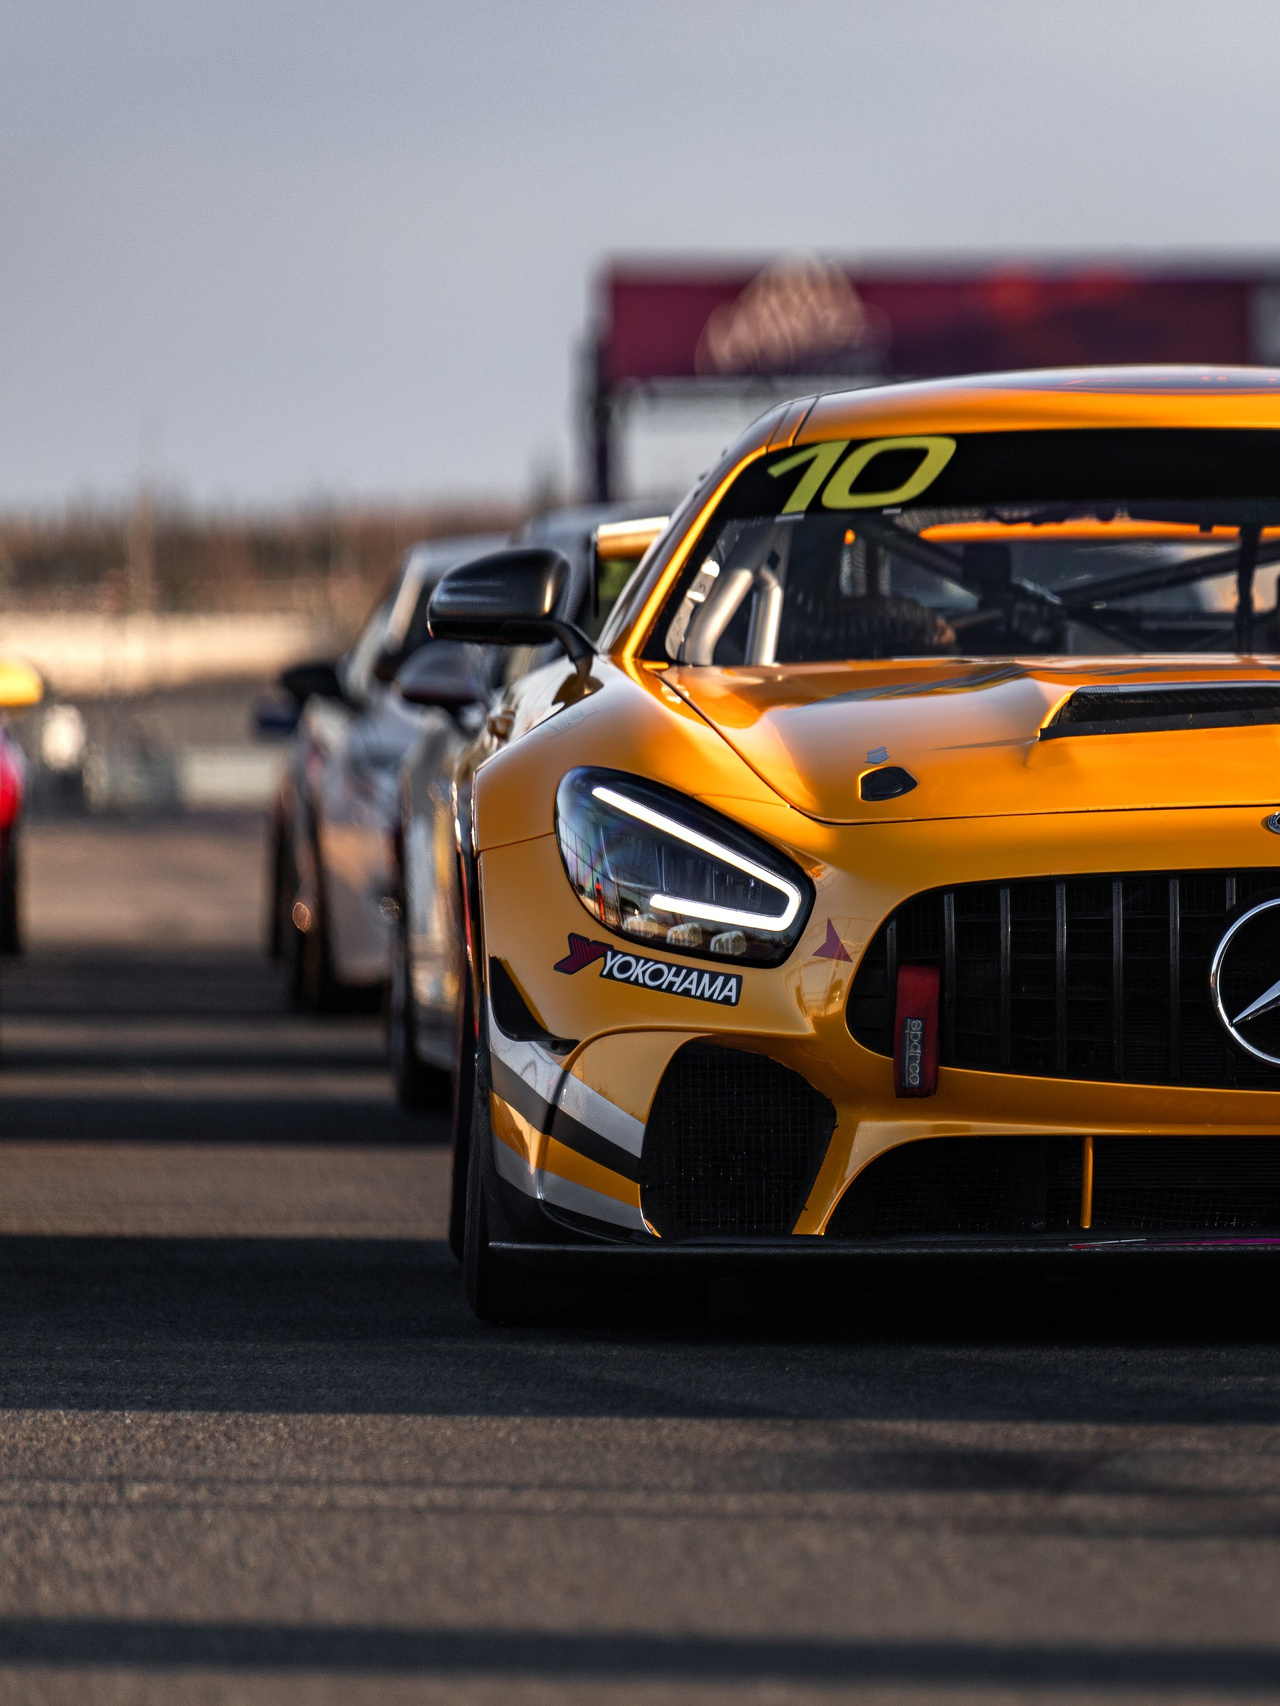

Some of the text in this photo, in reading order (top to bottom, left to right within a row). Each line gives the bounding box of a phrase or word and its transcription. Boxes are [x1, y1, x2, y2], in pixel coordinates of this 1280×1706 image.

[767, 436, 957, 515] 10
[602, 951, 738, 1004] YOKOHAMA
[908, 1019, 922, 1086] sparco
